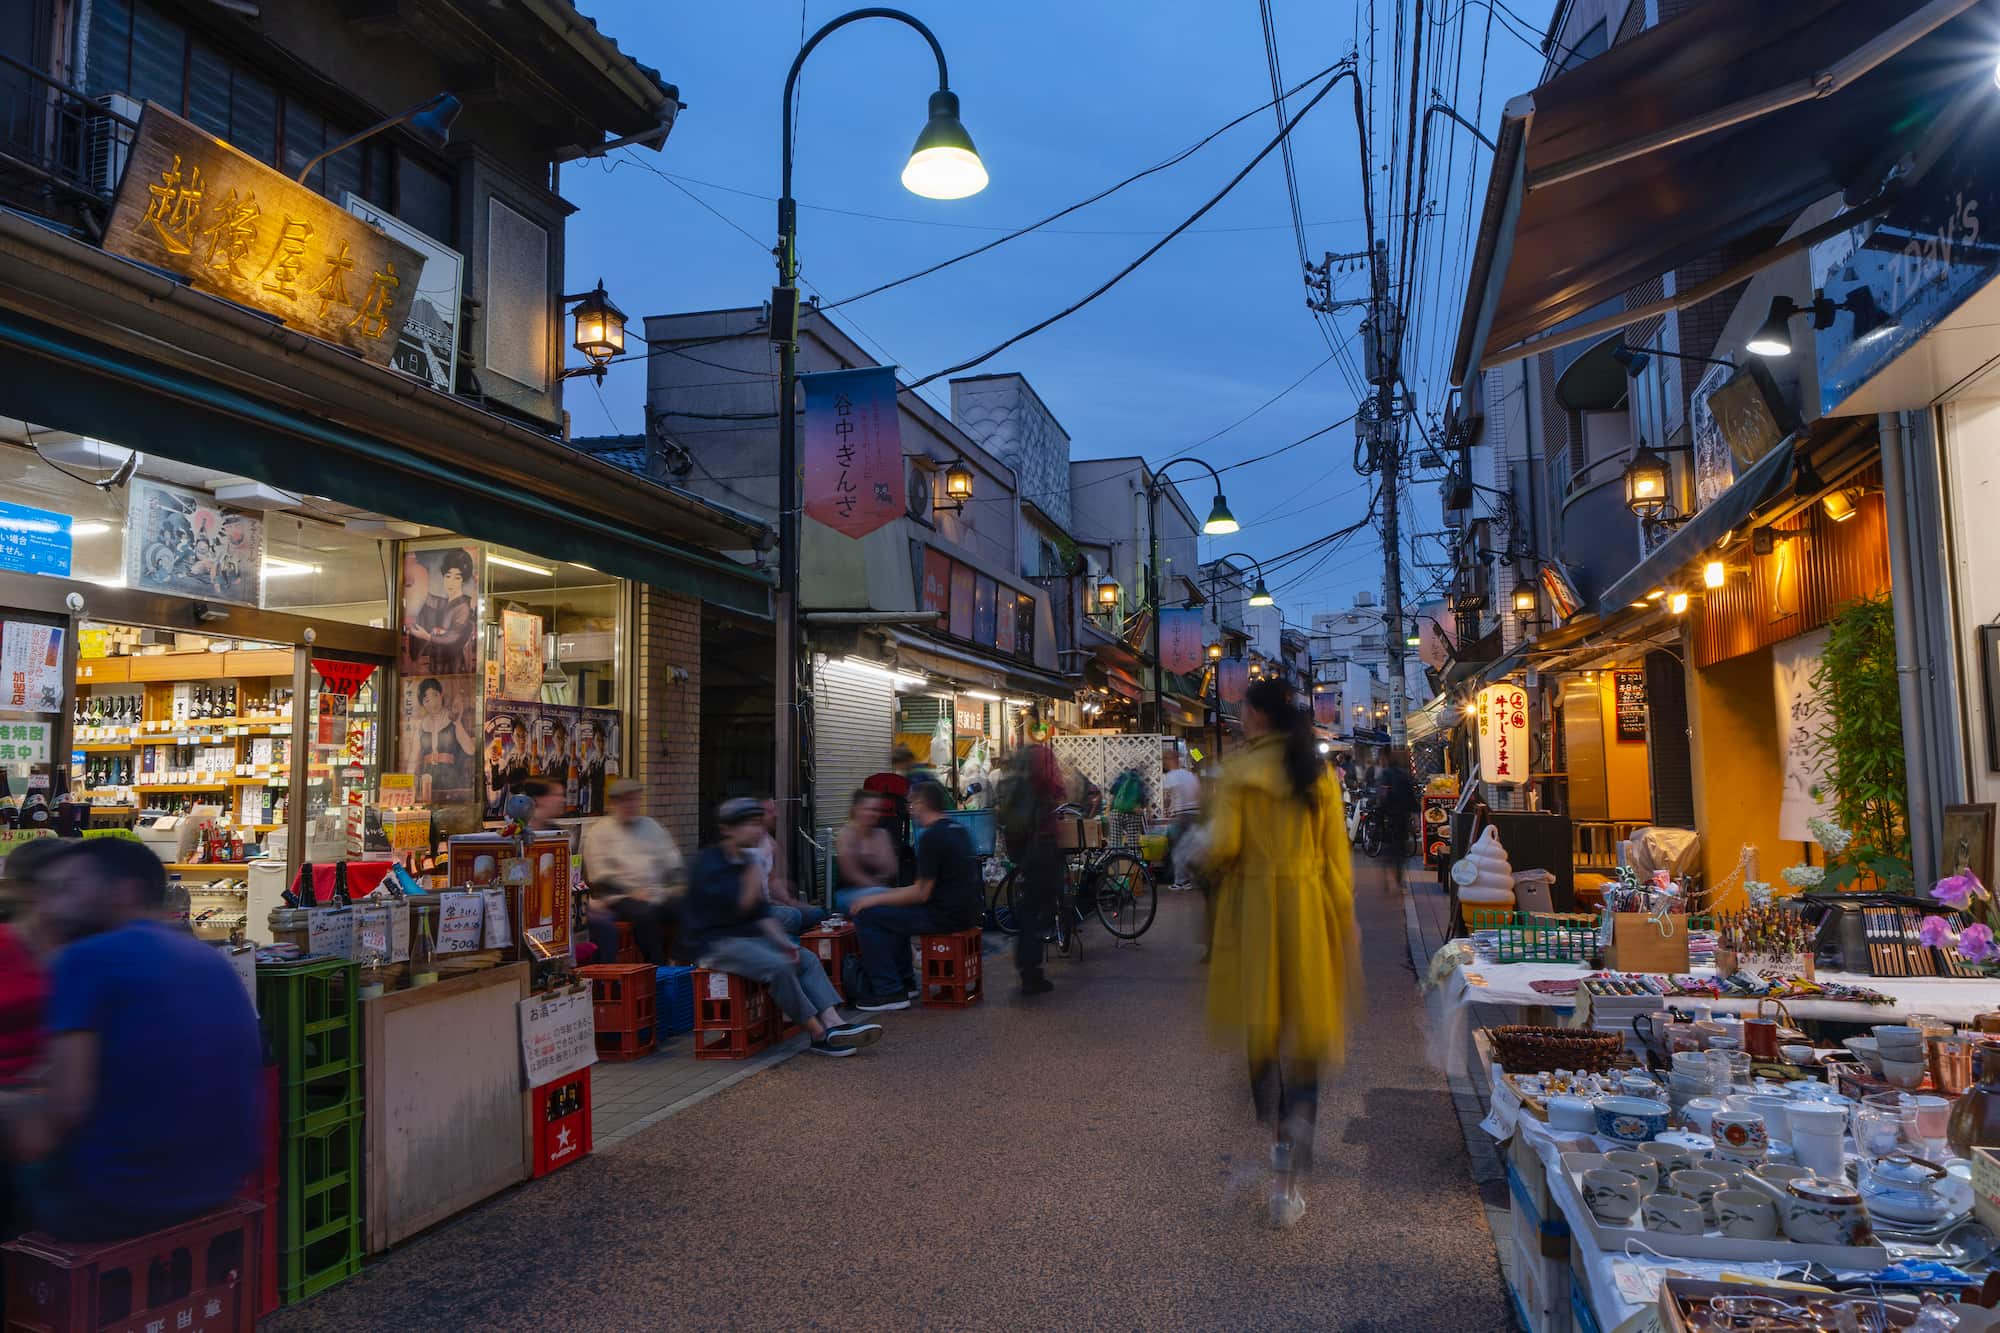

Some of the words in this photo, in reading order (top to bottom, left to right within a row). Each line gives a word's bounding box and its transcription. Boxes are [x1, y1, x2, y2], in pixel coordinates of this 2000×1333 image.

[133, 154, 400, 340] 越後屋本店
[832, 392, 857, 518] 谷中ぎんざ
[11, 671, 25, 706] 加盟店
[319, 676, 369, 699] DRY
[328, 662, 361, 673] SUPER
[1494, 694, 1511, 776] 牛すじうま煮
[1511, 693, 1525, 727] 名物
[346, 790, 363, 859] UPER
